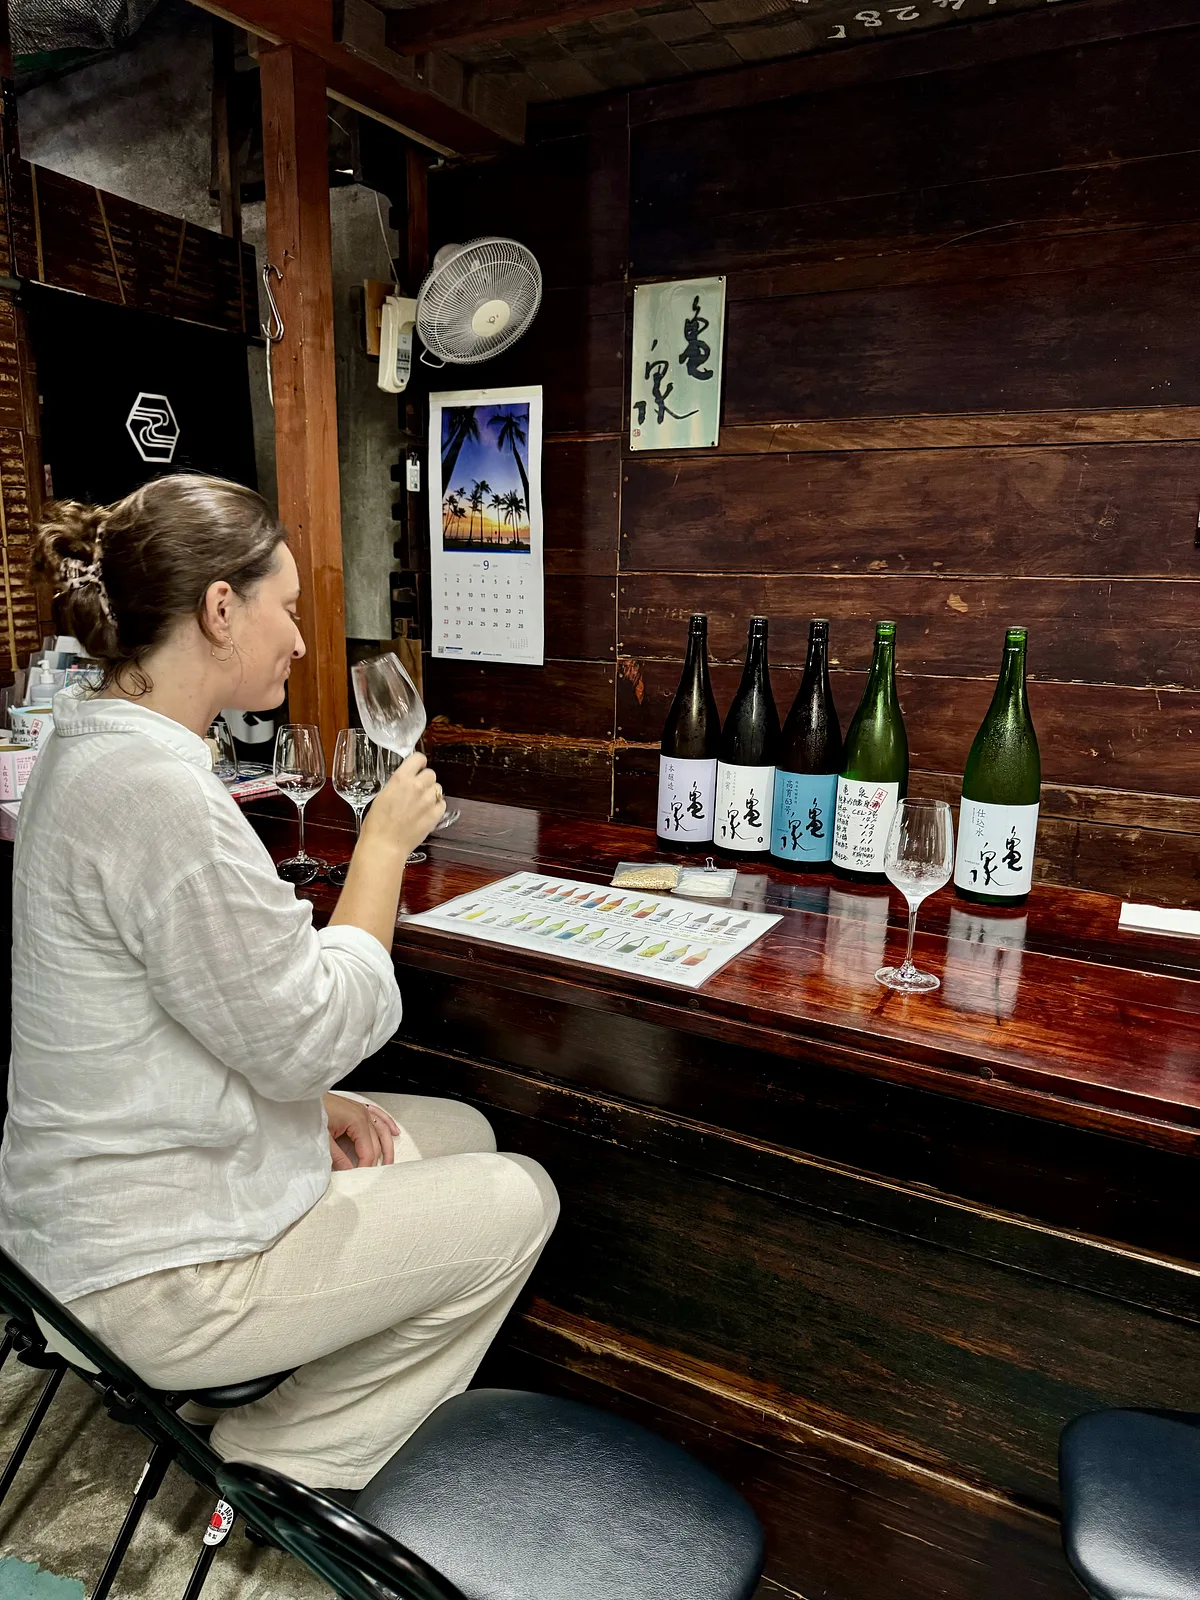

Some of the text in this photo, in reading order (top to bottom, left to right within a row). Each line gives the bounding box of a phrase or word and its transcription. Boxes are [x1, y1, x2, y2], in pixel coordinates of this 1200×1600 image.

[483, 560, 489, 570] 9
[975, 808, 986, 837] 仕込水
